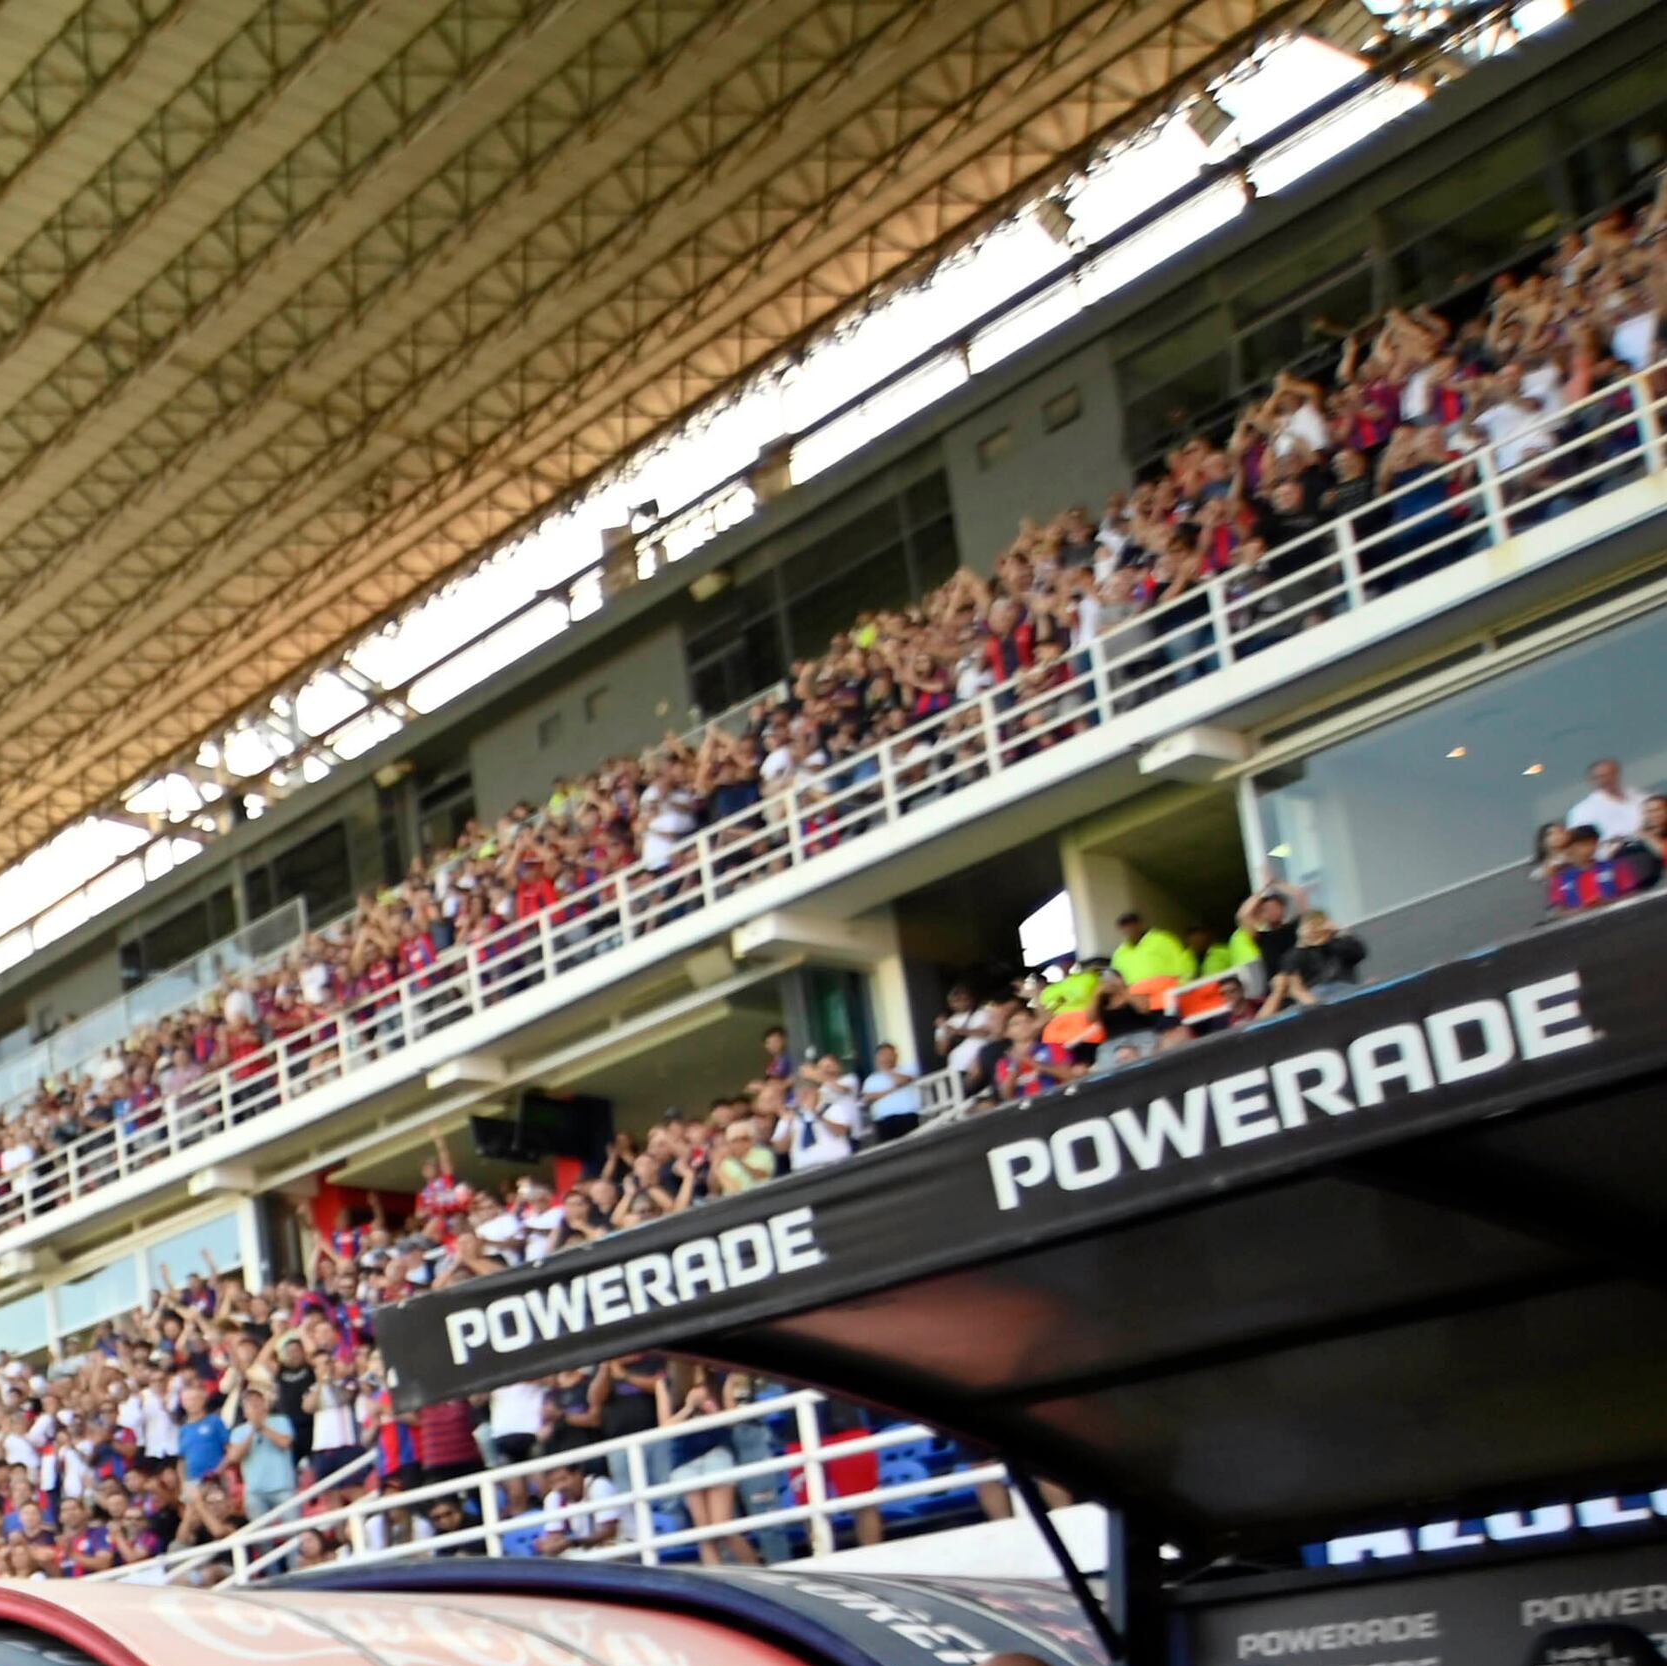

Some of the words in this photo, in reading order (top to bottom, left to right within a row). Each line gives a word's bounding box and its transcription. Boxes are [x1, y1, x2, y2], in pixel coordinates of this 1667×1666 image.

[986, 971, 1595, 1211] POWERADE
[445, 1206, 824, 1365] POWERADE
[1237, 1611, 1438, 1660] POWERADE
